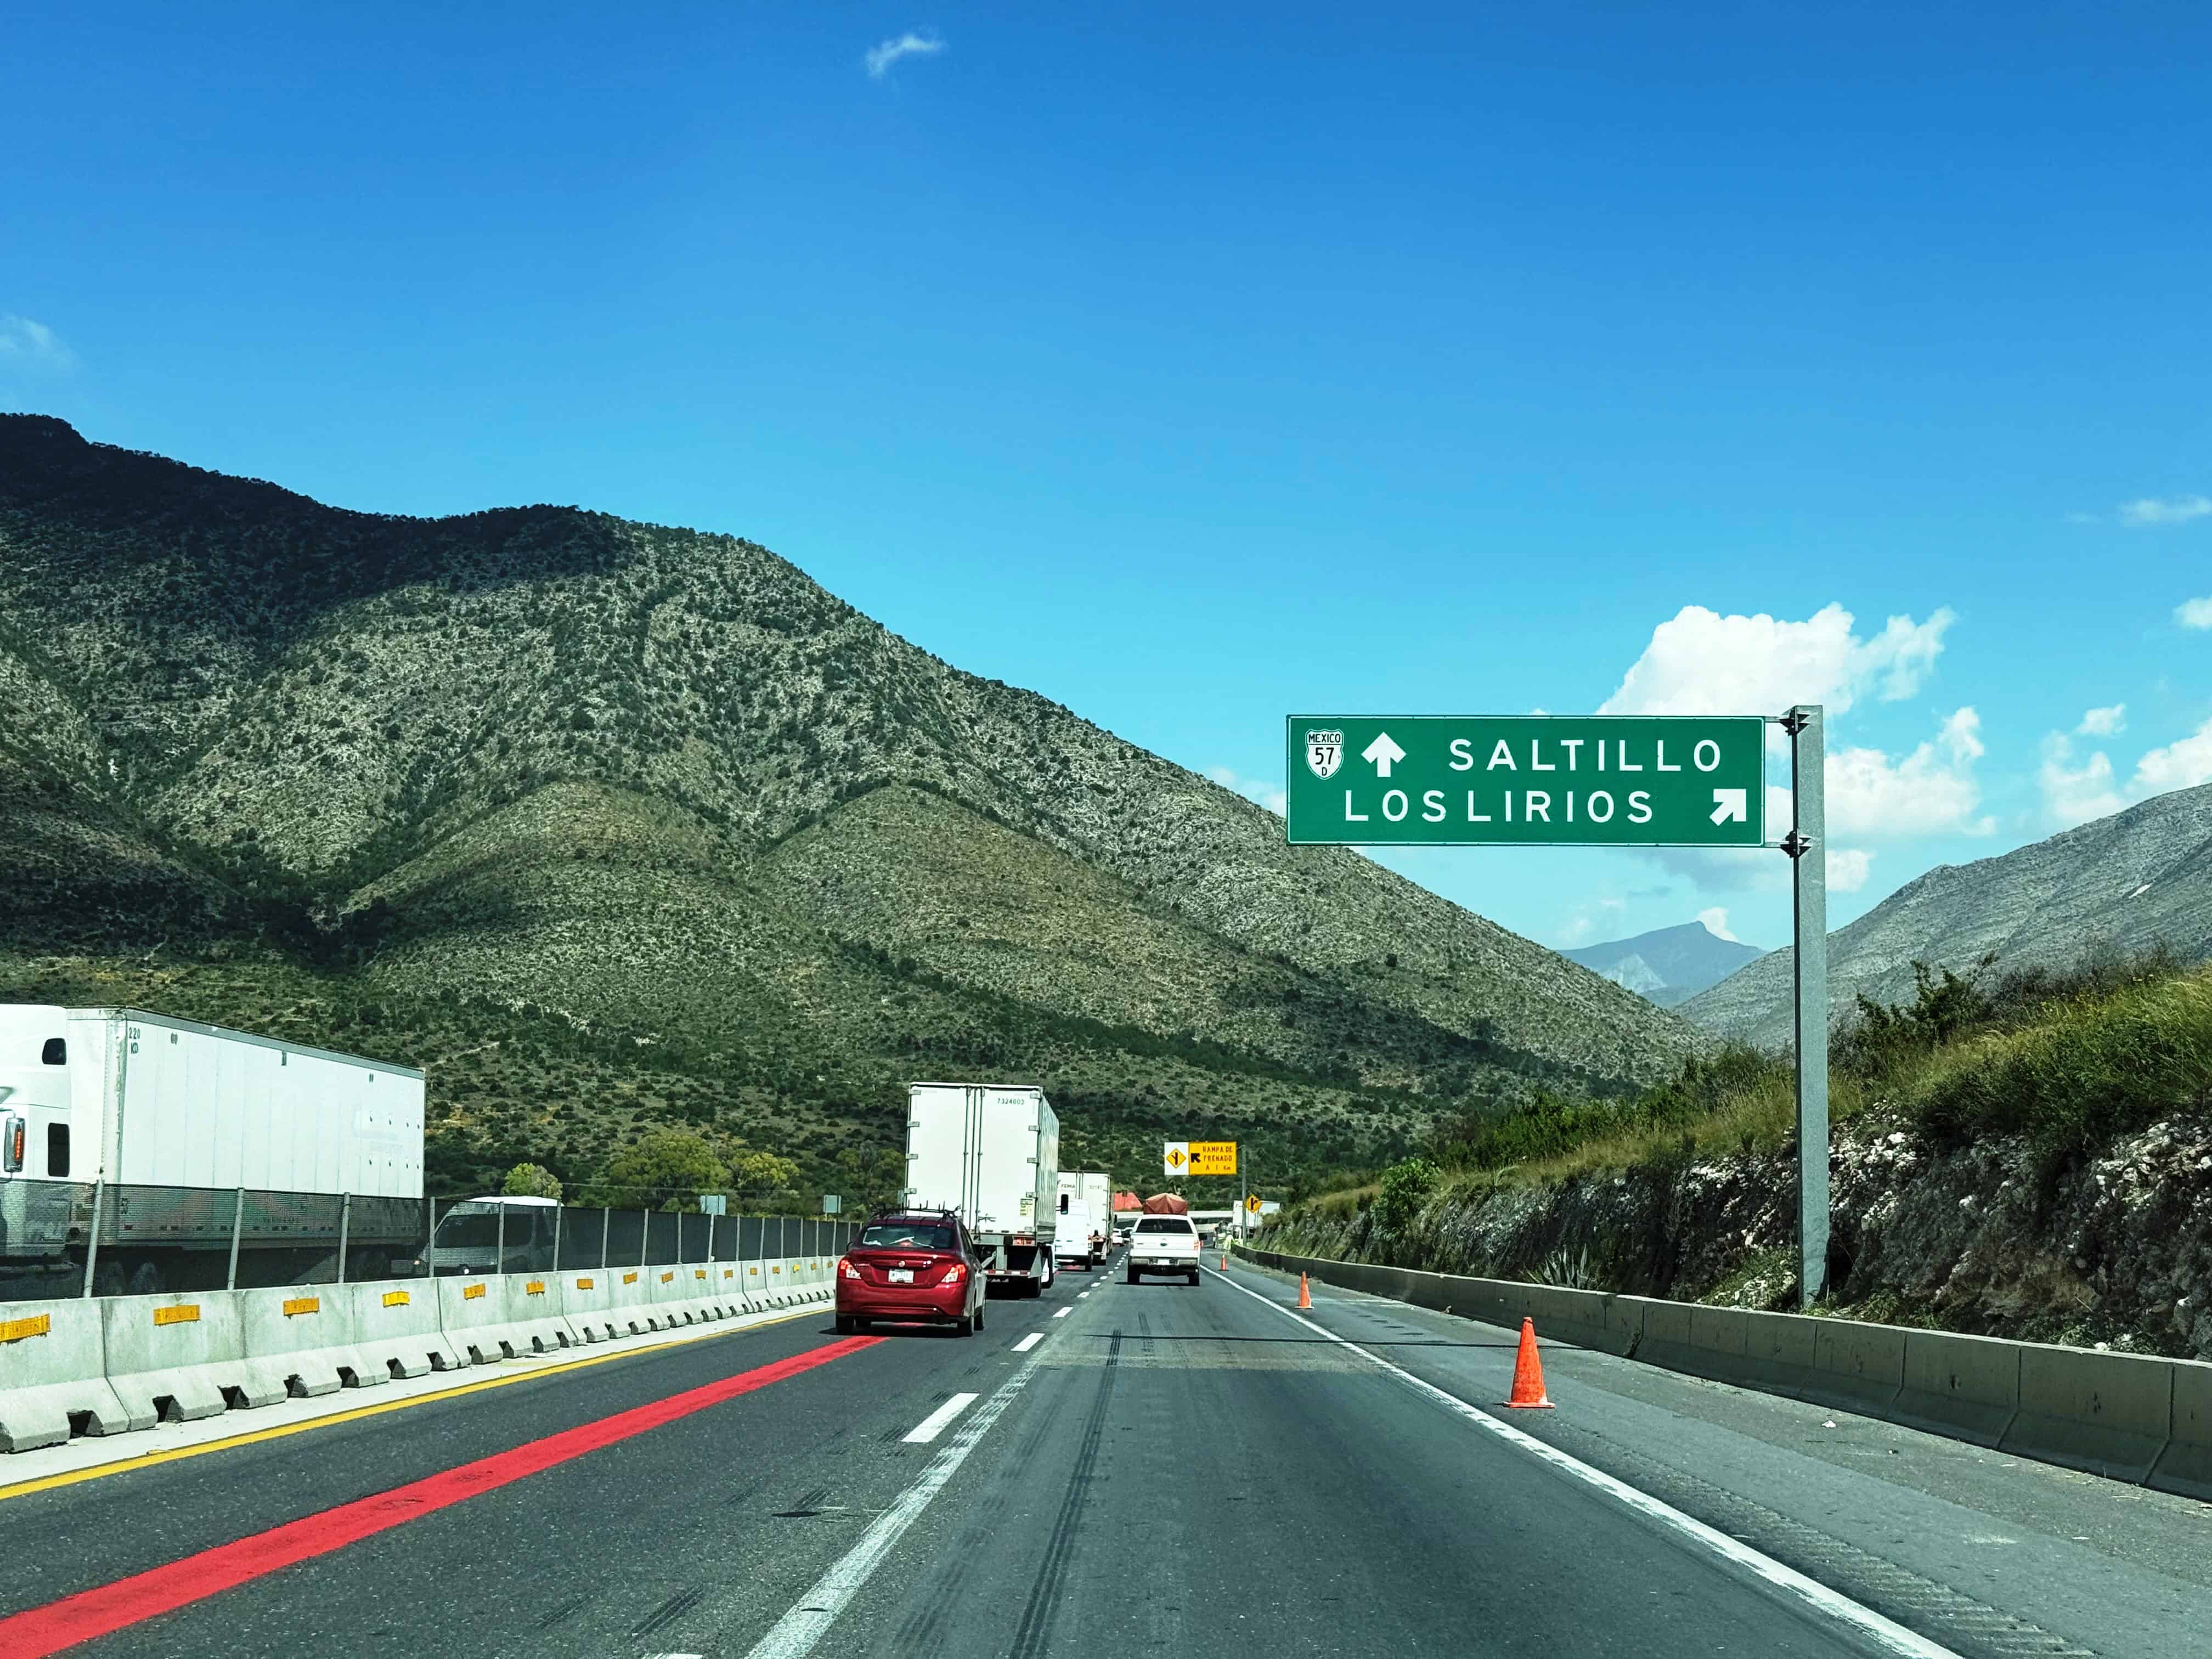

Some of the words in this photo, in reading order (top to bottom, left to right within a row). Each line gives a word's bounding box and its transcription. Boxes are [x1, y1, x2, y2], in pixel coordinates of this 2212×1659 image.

[1308, 733, 1341, 743] MEXICO
[1315, 747, 1334, 765] 57
[1450, 739, 1720, 771] SALTILLO
[1322, 767, 1328, 776] D
[1345, 790, 1447, 822] LOS
[1468, 791, 1653, 823] LIRIOS
[129, 1027, 140, 1039] 220
